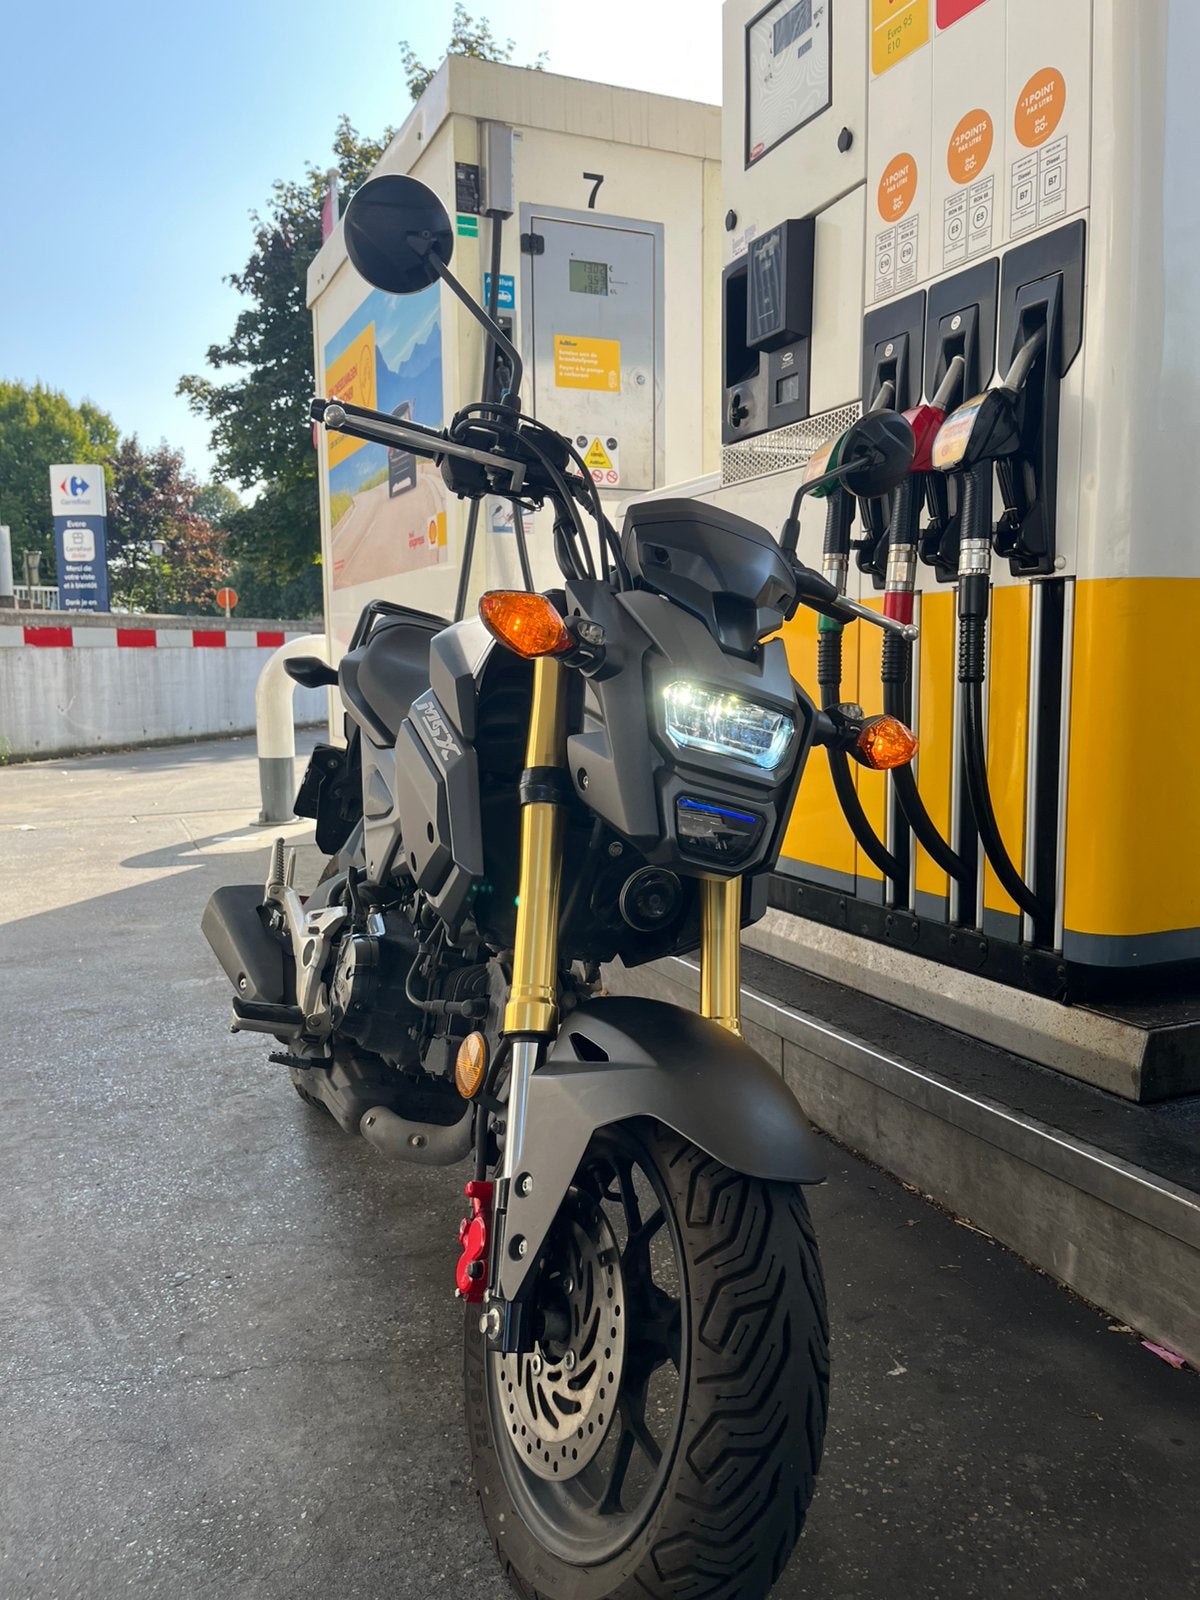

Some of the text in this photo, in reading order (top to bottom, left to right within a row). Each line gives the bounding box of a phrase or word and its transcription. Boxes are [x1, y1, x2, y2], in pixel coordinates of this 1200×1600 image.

[887, 14, 913, 40] Euro 95
[887, 37, 901, 54] E10
[1029, 81, 1055, 105] POINT
[1027, 94, 1053, 115] PAR LITRE
[960, 120, 987, 143] POINTS
[582, 171, 604, 209] 7
[1048, 175, 1058, 187] B7
[1020, 189, 1029, 201] B7
[976, 211, 985, 222] E5
[951, 223, 959, 234] E5
[902, 247, 912, 258] E10
[415, 701, 463, 761] MSX
